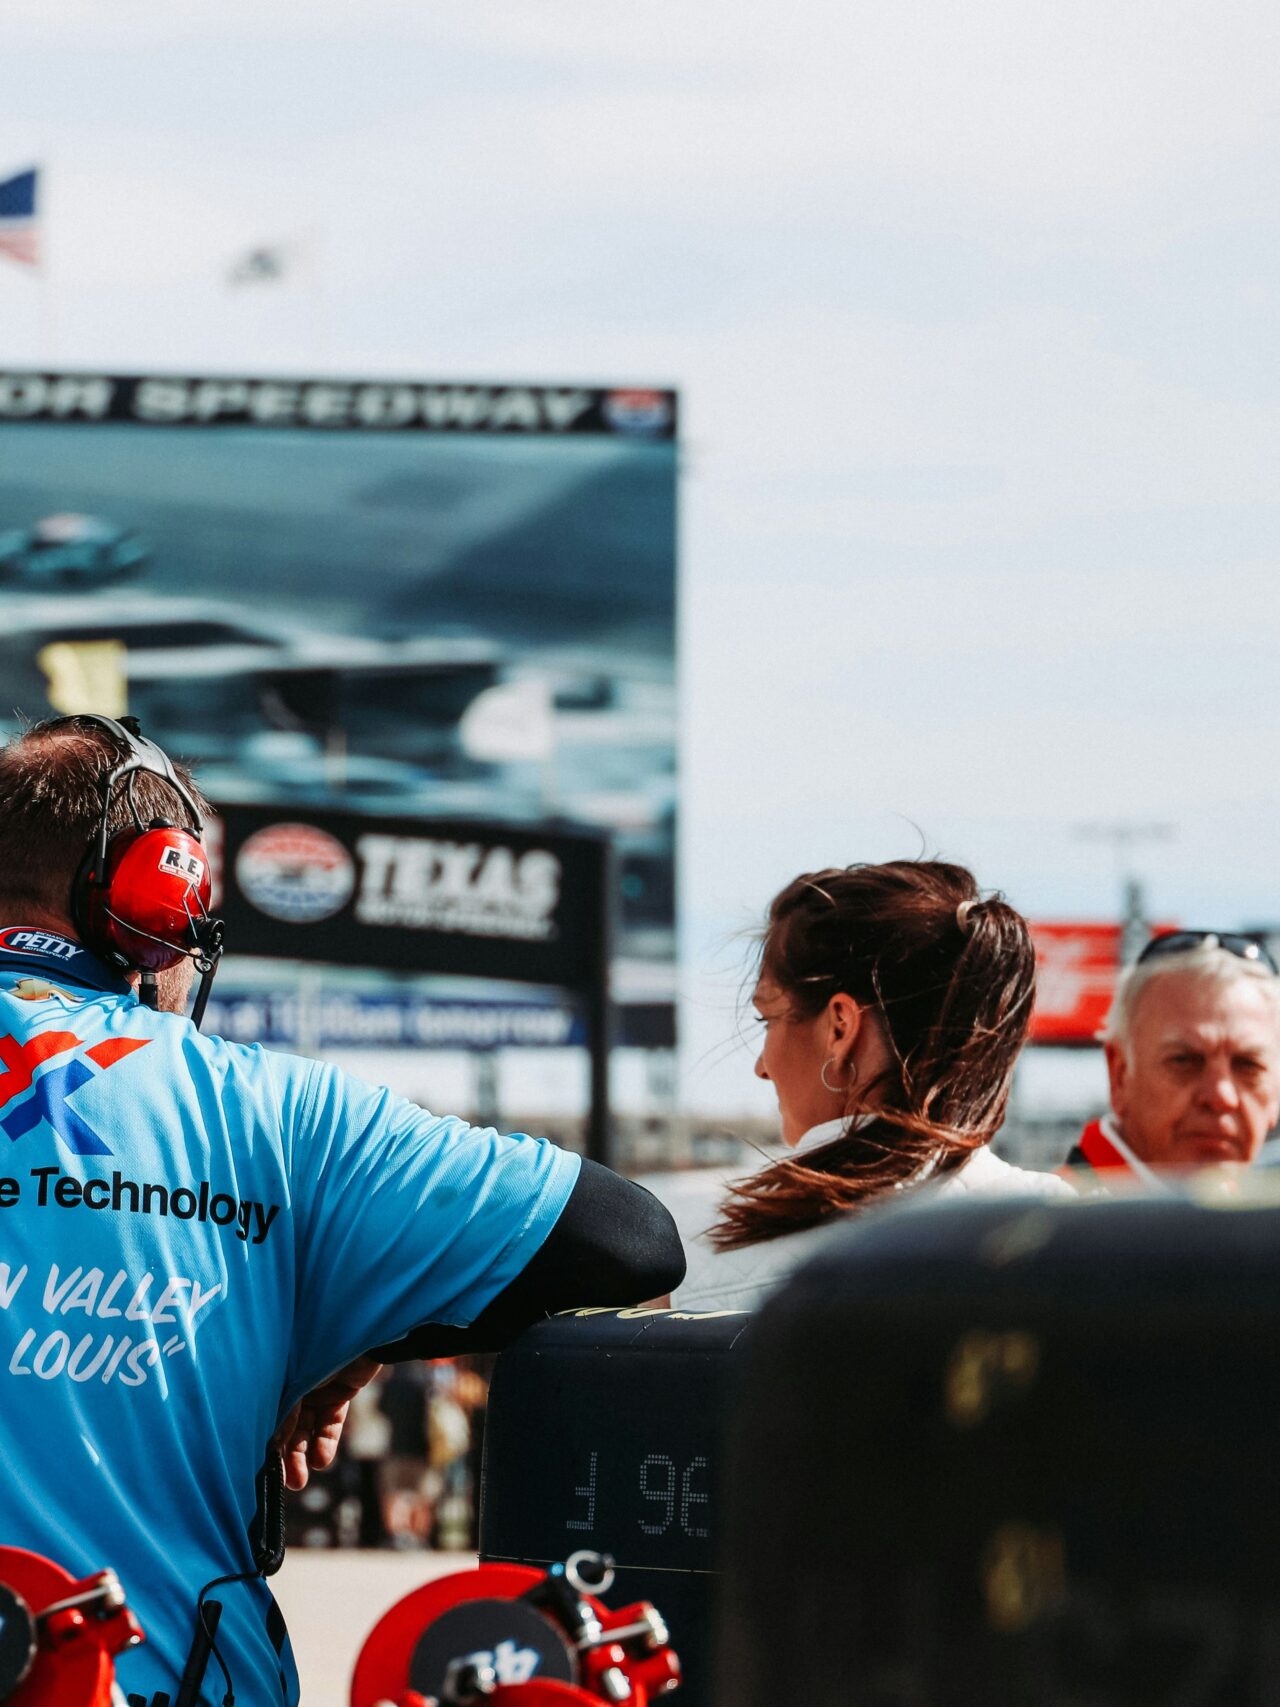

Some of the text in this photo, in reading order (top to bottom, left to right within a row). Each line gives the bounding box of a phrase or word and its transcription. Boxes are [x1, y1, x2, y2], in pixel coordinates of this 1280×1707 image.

[132, 377, 594, 432] SPEEDWAY
[355, 833, 562, 918] TEXAS
[10, 932, 86, 959] PETTY
[29, 1165, 280, 1245] Technology
[41, 1263, 223, 1326] VALLEY
